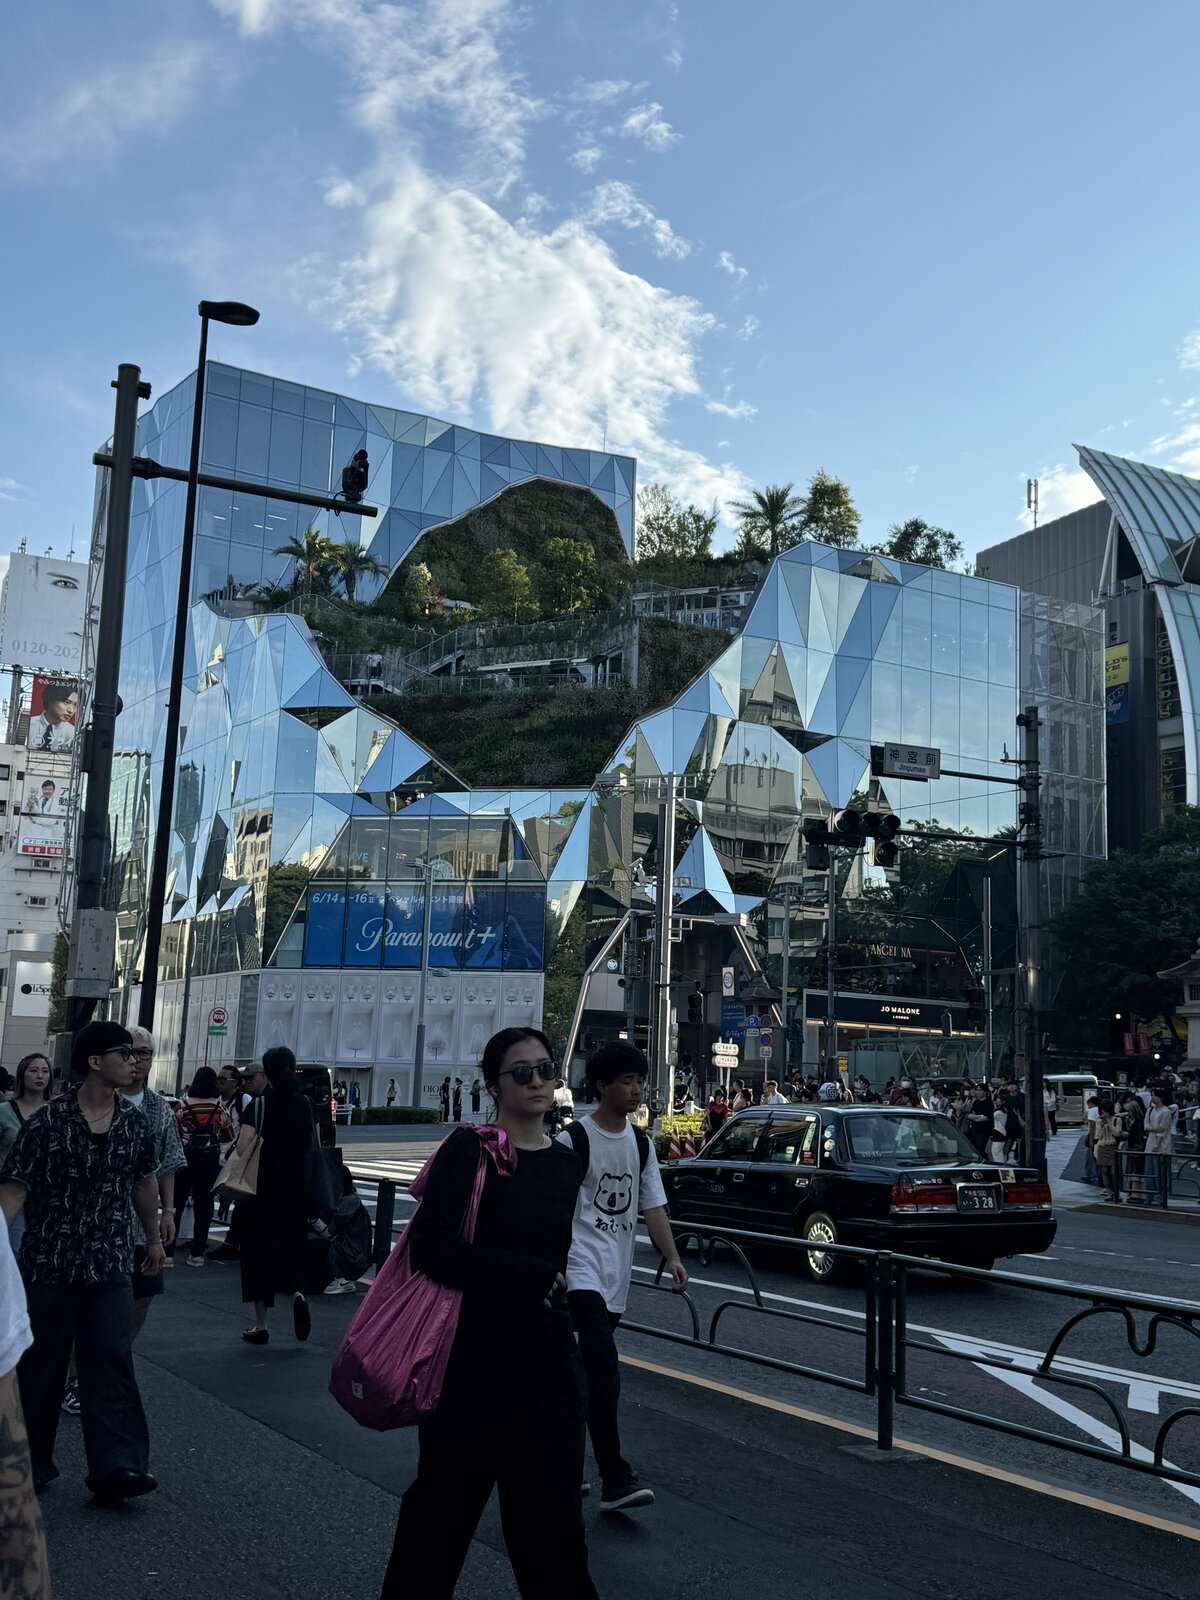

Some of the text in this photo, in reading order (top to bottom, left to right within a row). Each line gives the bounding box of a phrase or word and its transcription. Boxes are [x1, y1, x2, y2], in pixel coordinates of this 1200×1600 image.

[889, 747, 936, 766] 神宮前
[898, 763, 926, 774] Jingumae
[355, 917, 496, 952] Paramount+
[880, 1005, 921, 1015] JO MALONE
[594, 1215, 633, 1234] ねむい
